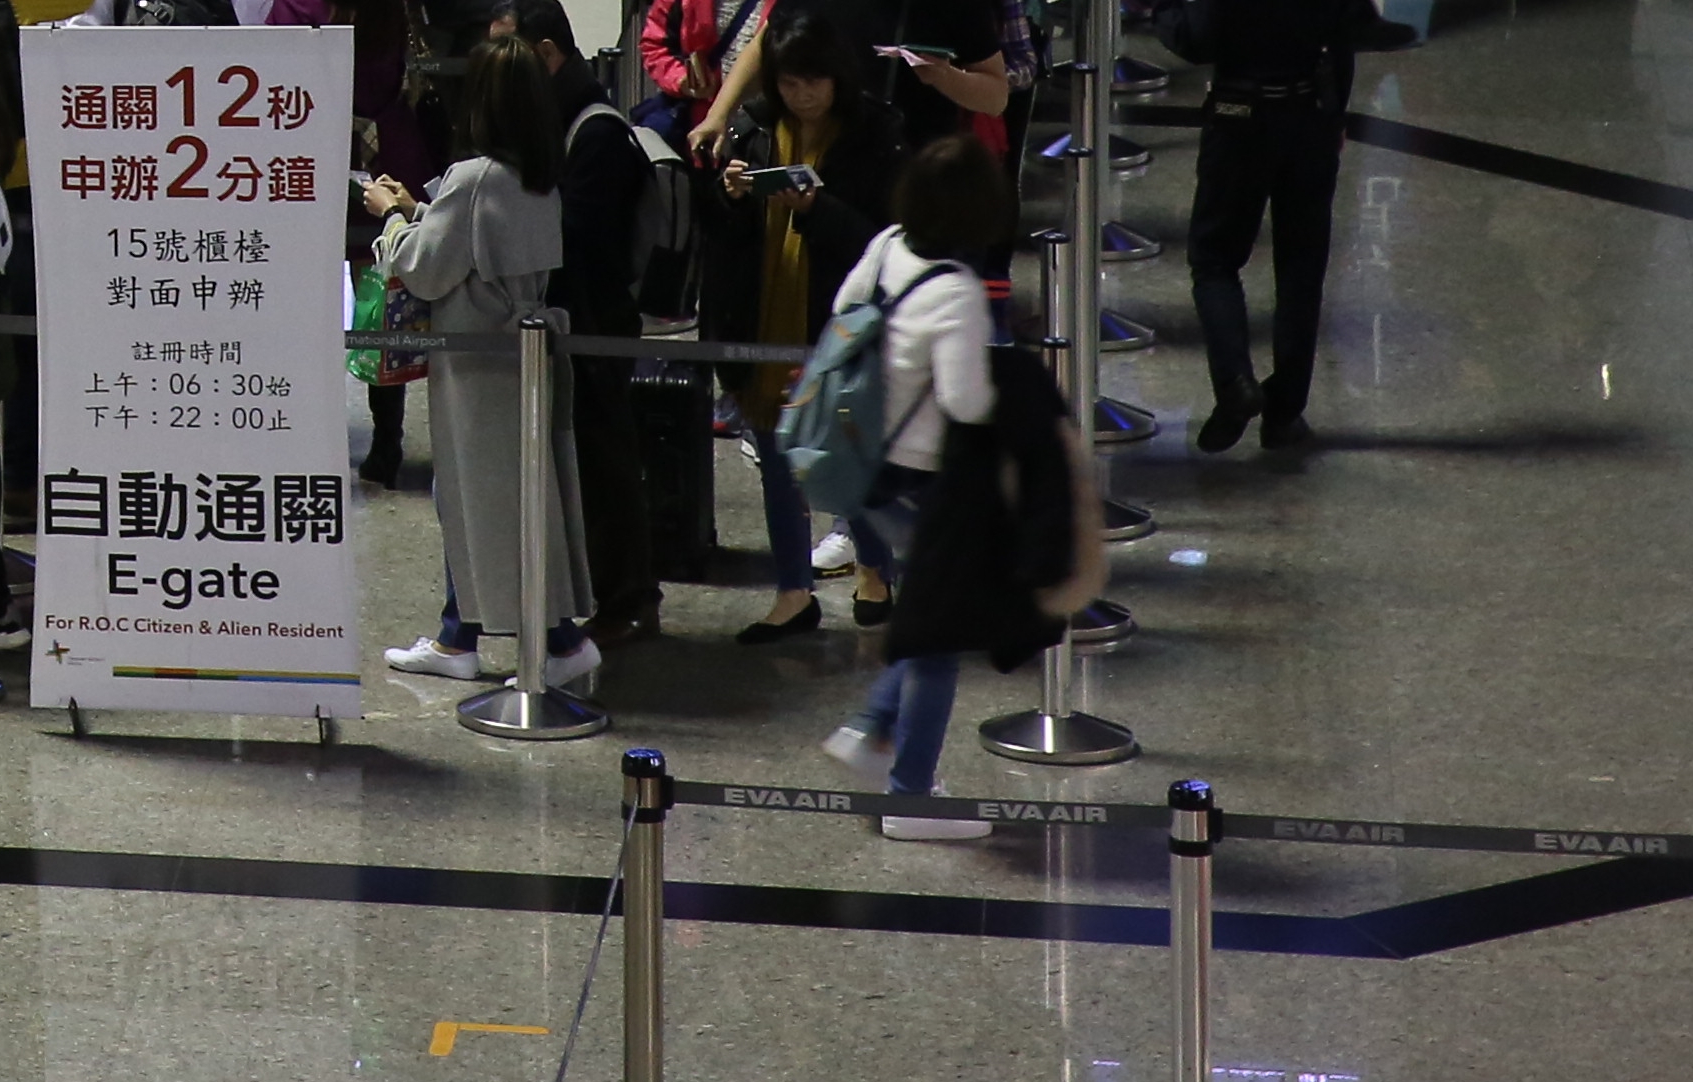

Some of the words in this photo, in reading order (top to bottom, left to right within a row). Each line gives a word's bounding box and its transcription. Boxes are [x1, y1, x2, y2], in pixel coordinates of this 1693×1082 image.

[61, 64, 314, 131] 通關12秒
[61, 135, 316, 202] 申辦2分鐘
[107, 228, 271, 264] 15號櫃檯
[106, 275, 265, 311] 對面申辦
[131, 340, 242, 365] 註冊時間
[402, 334, 446, 349] Airport
[44, 468, 344, 544] 自動通關
[108, 553, 280, 610] E-gate
[46, 615, 74, 630] For
[79, 616, 130, 632] R.O.C
[134, 618, 194, 634] Citizen
[199, 620, 213, 635] &
[217, 620, 262, 636] Alien
[267, 623, 344, 639] Resident
